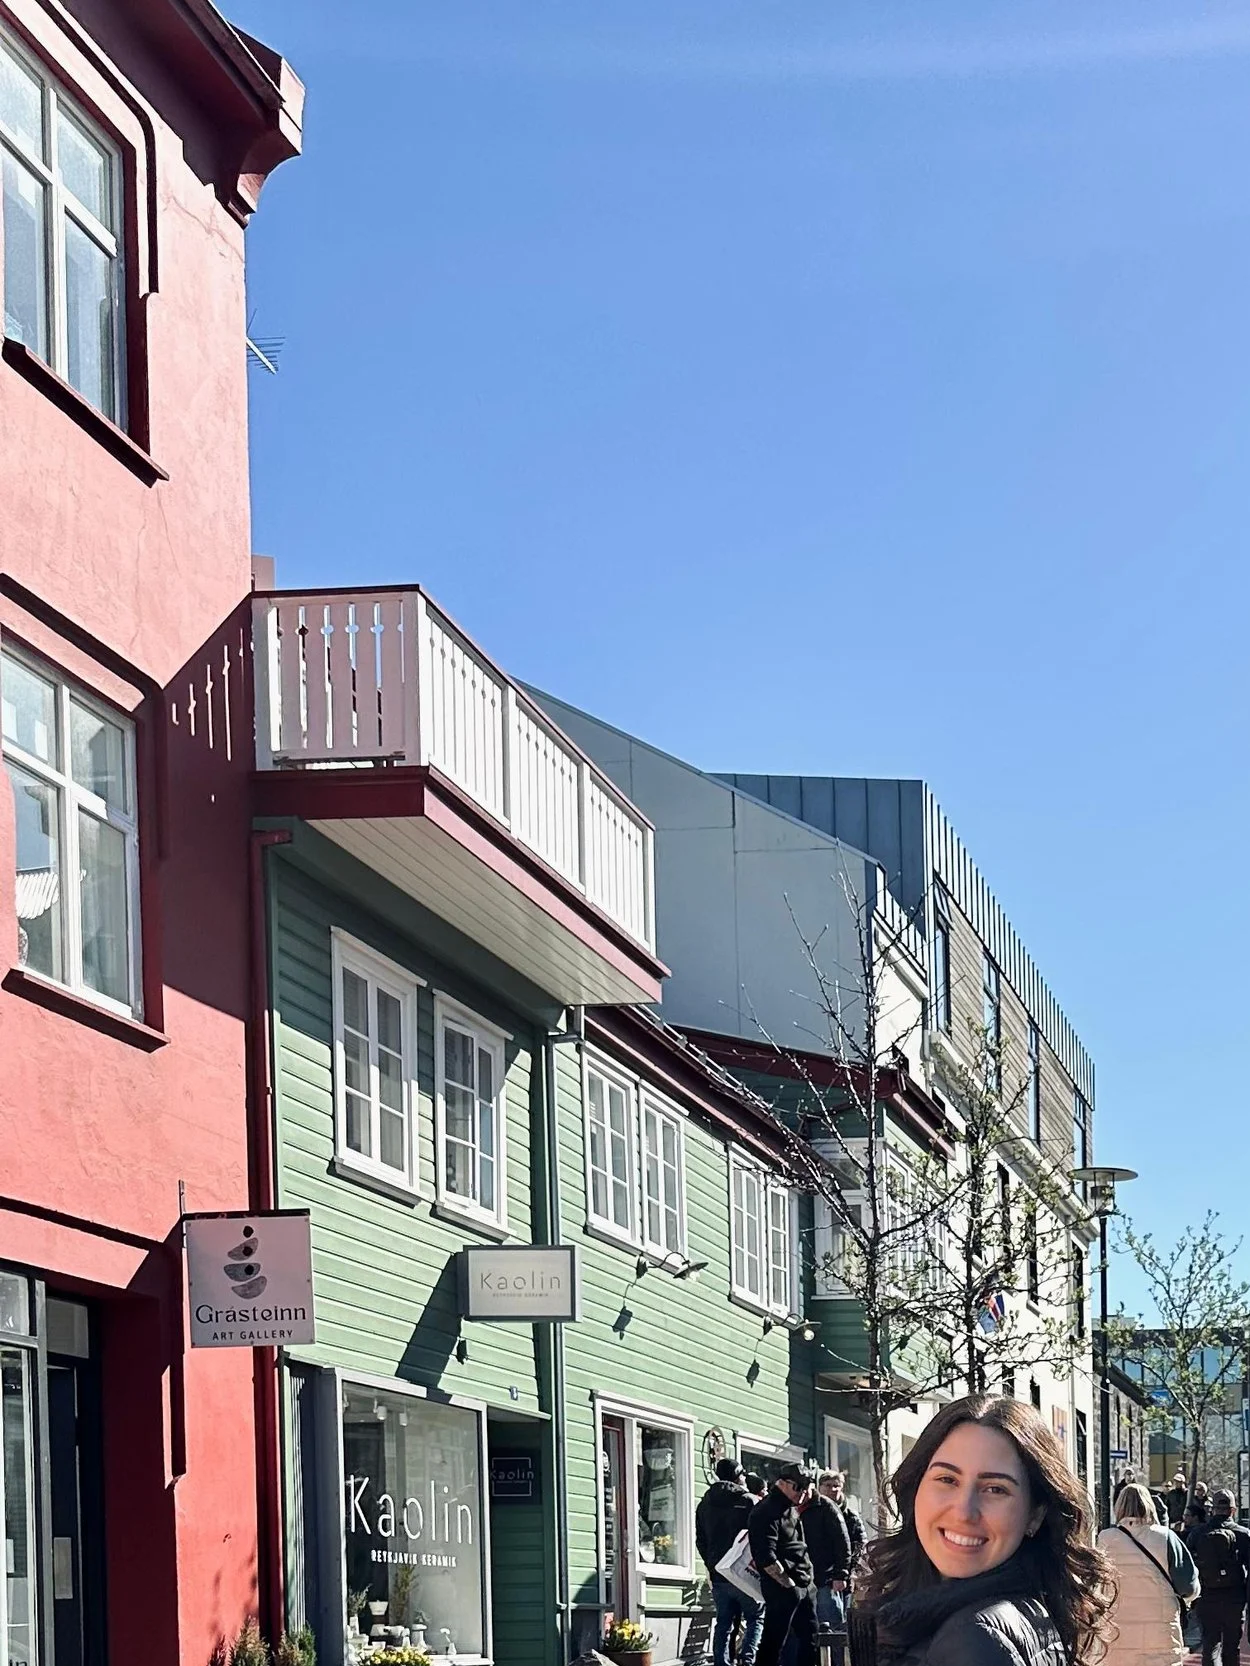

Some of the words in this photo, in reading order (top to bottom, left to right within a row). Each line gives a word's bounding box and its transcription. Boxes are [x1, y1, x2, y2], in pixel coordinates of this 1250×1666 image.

[480, 1270, 561, 1290] Kaolin
[195, 1304, 306, 1324] Grásteinn
[212, 1332, 234, 1341] ART
[240, 1330, 293, 1340] GALLERY
[490, 1468, 534, 1480] Kaolin
[350, 1474, 472, 1544] Kaolin
[371, 1549, 418, 1565] REYKJAVIK
[422, 1554, 457, 1568] KERAMIK
